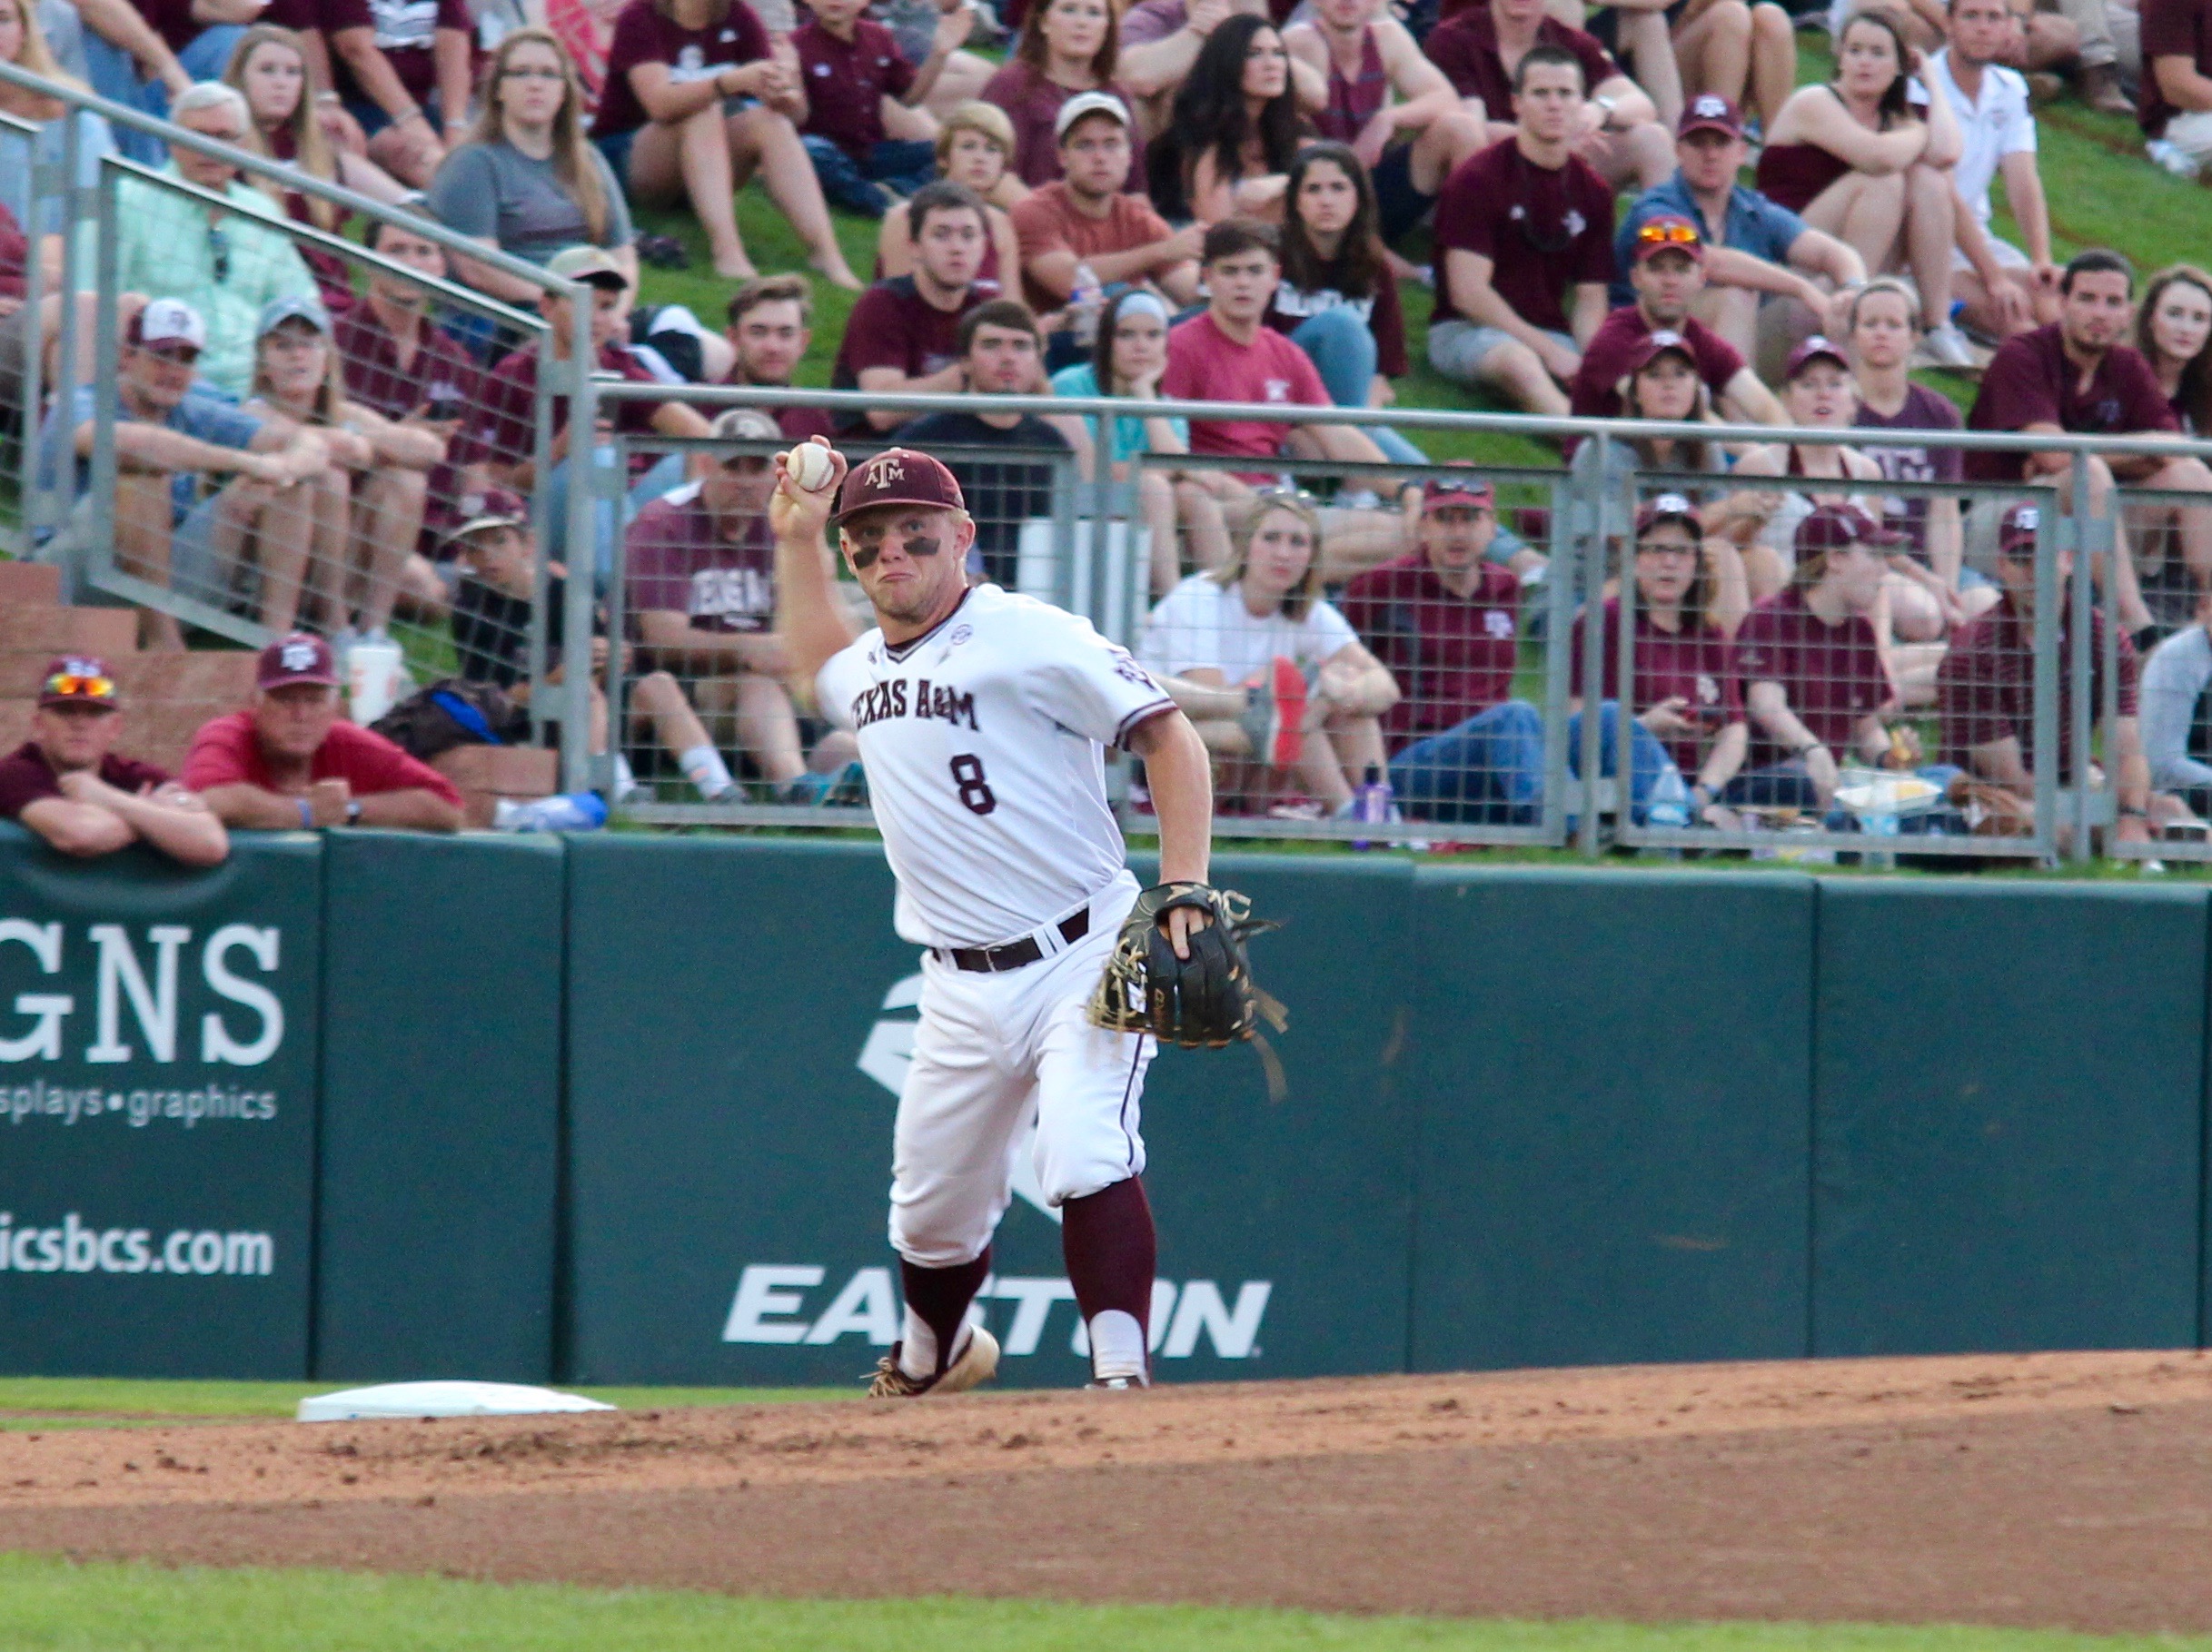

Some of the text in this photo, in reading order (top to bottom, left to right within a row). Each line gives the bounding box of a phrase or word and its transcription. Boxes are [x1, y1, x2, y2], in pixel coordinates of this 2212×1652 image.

[851, 678, 980, 731] EXAS A&M
[949, 753, 997, 815] 8
[0, 917, 284, 1066] GNS
[0, 1211, 273, 1275] icsbcs.com
